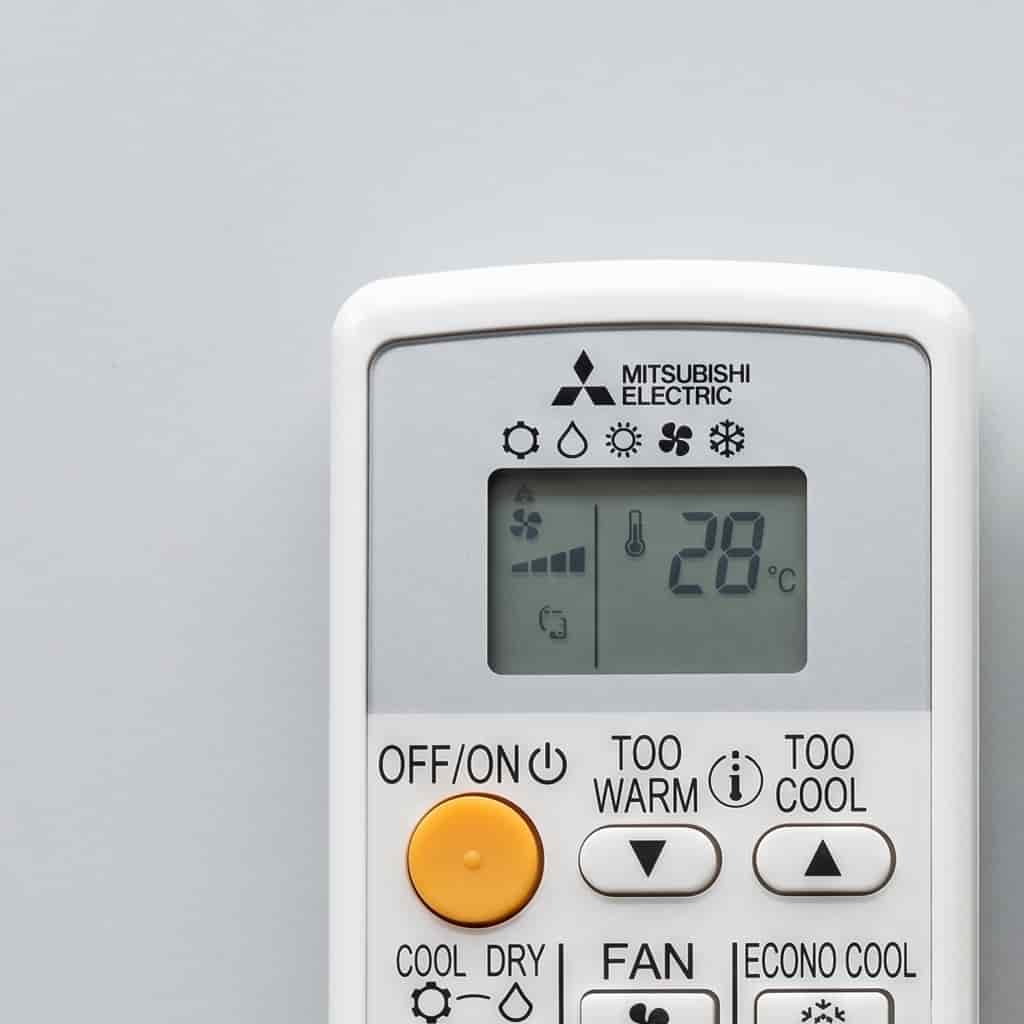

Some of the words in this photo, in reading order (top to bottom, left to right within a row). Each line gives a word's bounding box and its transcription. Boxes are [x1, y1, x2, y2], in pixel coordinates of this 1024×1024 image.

[622, 364, 751, 384] MITSUBISHI
[622, 386, 733, 406] ELECTRIC
[378, 744, 520, 785] OFF/ON
[611, 734, 682, 771] TOO
[784, 734, 855, 770] TOO
[593, 778, 699, 813] WARM
[775, 776, 868, 813] COOL
[395, 944, 466, 978] COOL
[486, 944, 545, 977] DRY
[603, 943, 695, 980] FAN
[745, 942, 837, 979] ECONO
[845, 942, 917, 979] COOL
